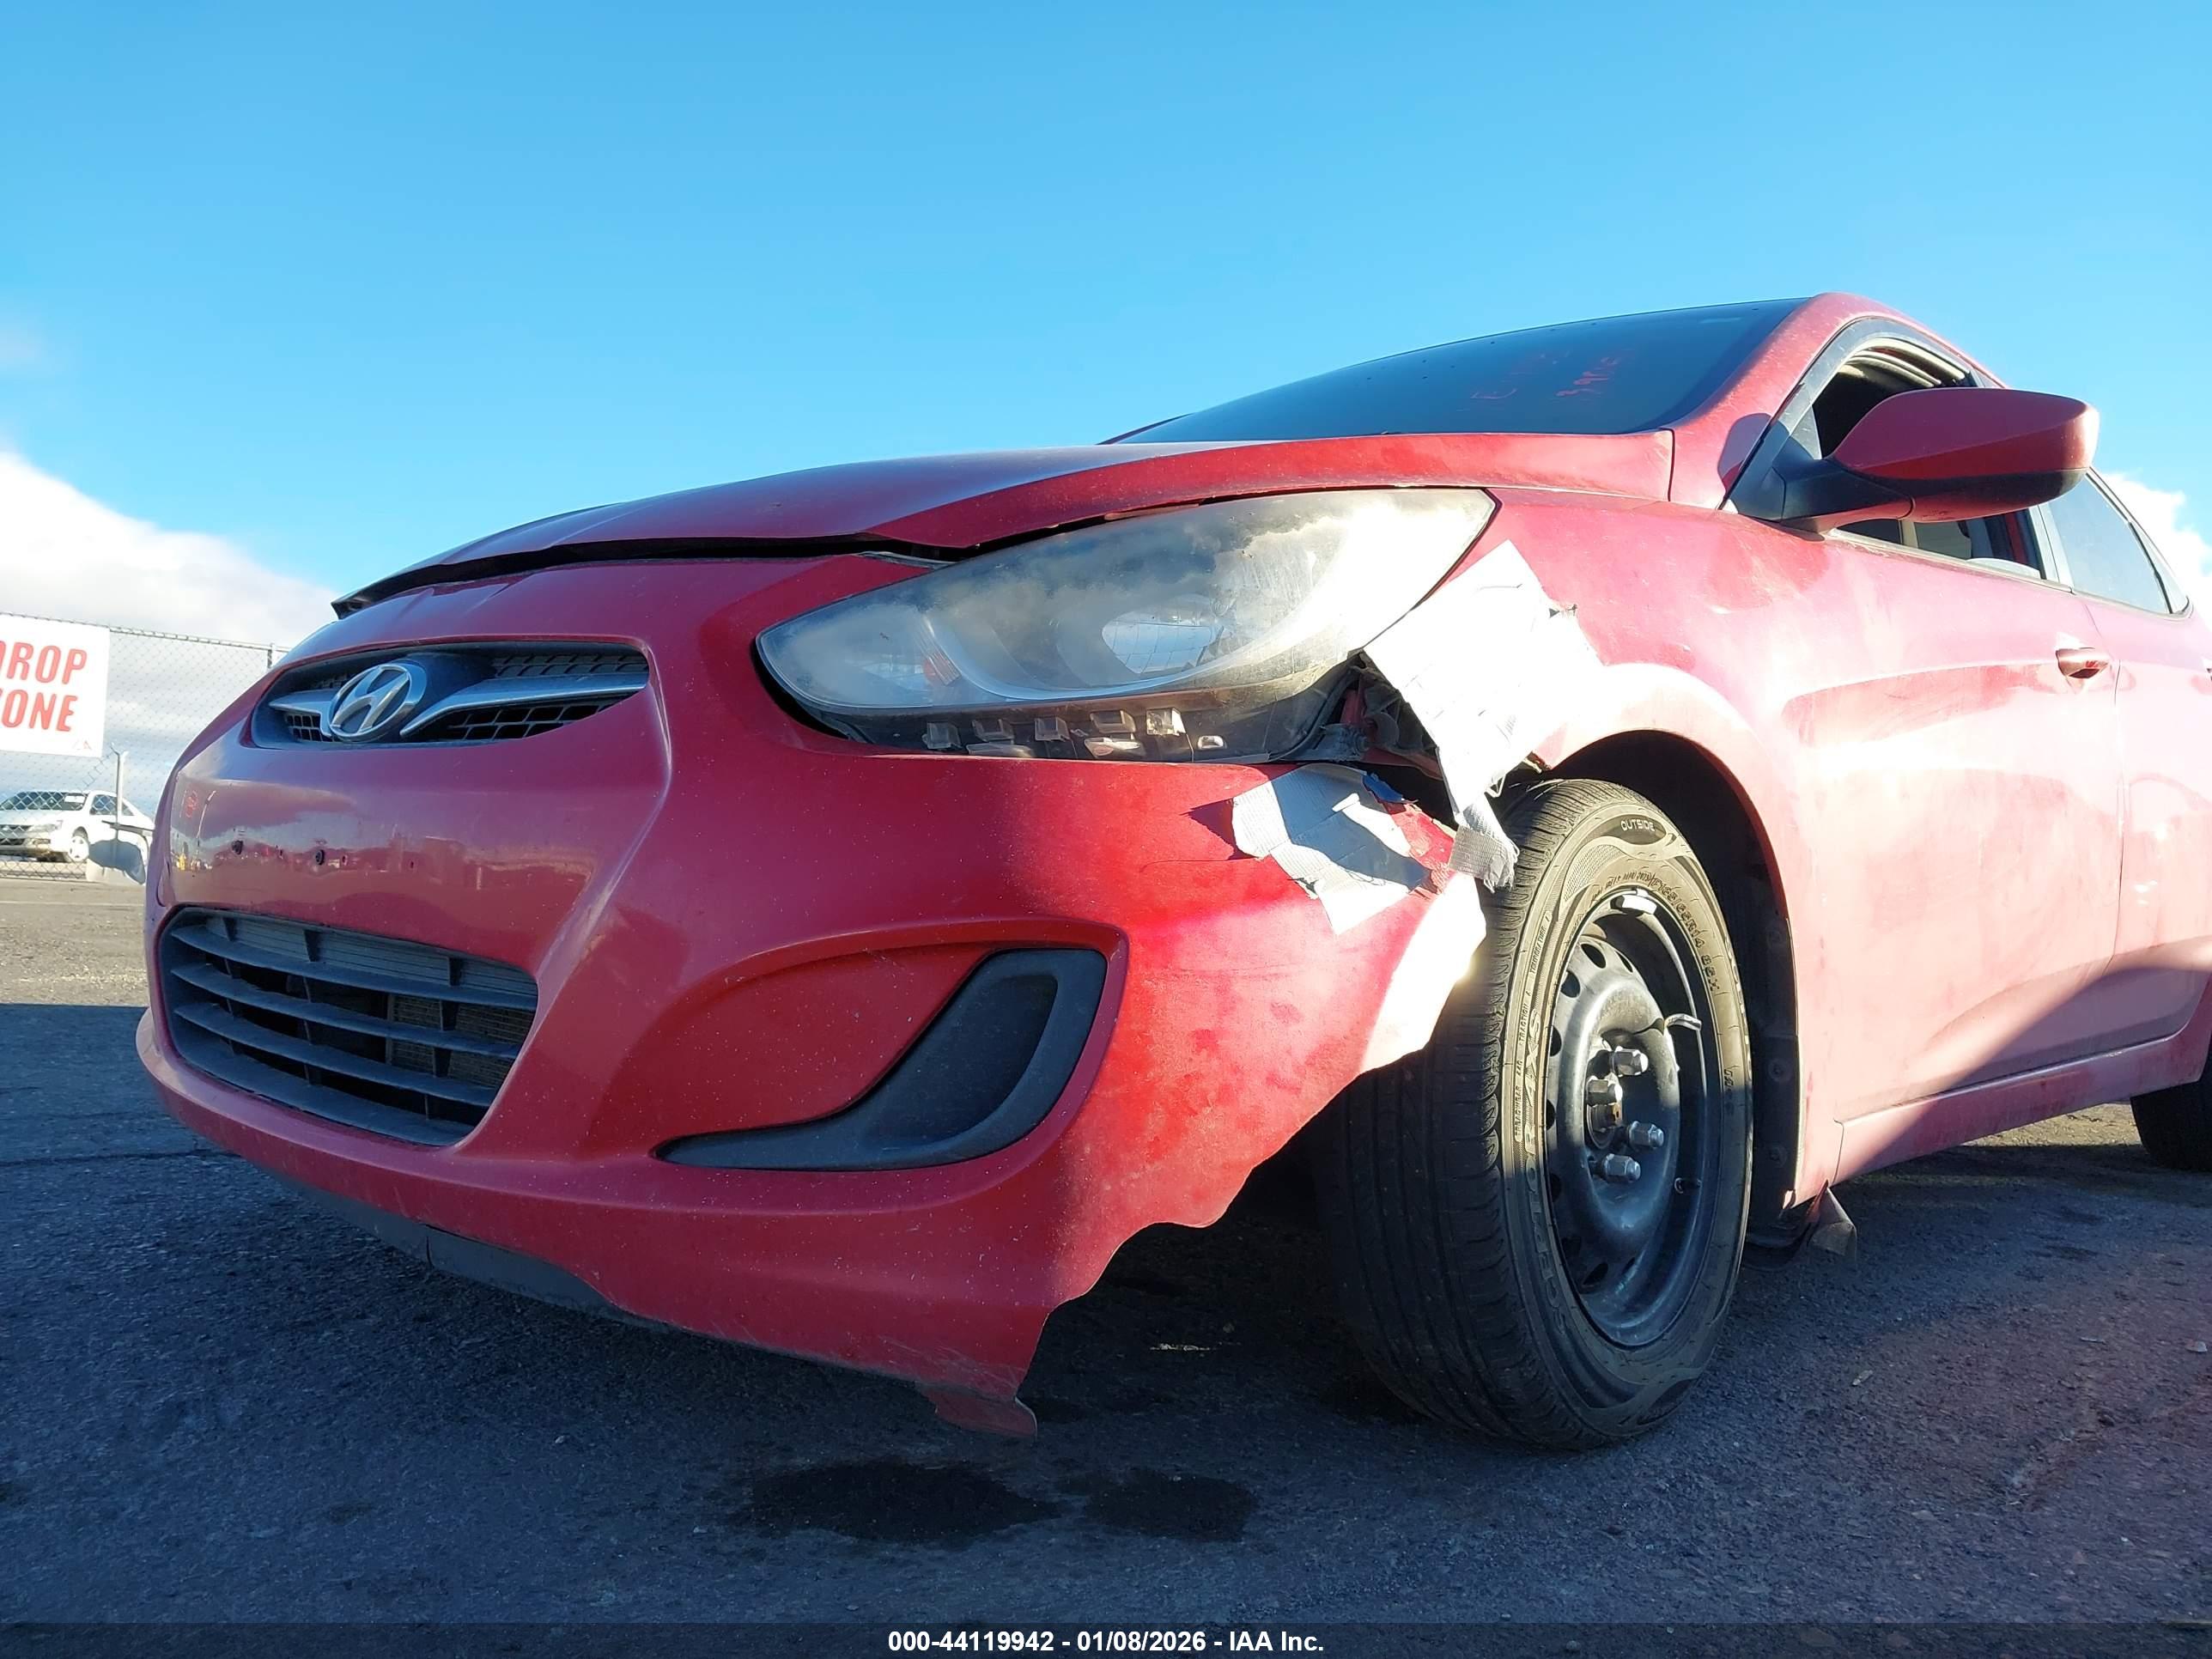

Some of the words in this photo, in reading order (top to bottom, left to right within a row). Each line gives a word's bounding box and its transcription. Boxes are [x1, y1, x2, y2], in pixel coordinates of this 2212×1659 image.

[0, 641, 88, 684] ROP
[0, 689, 78, 732] ONE
[1620, 818, 1656, 832] OUTSIDE
